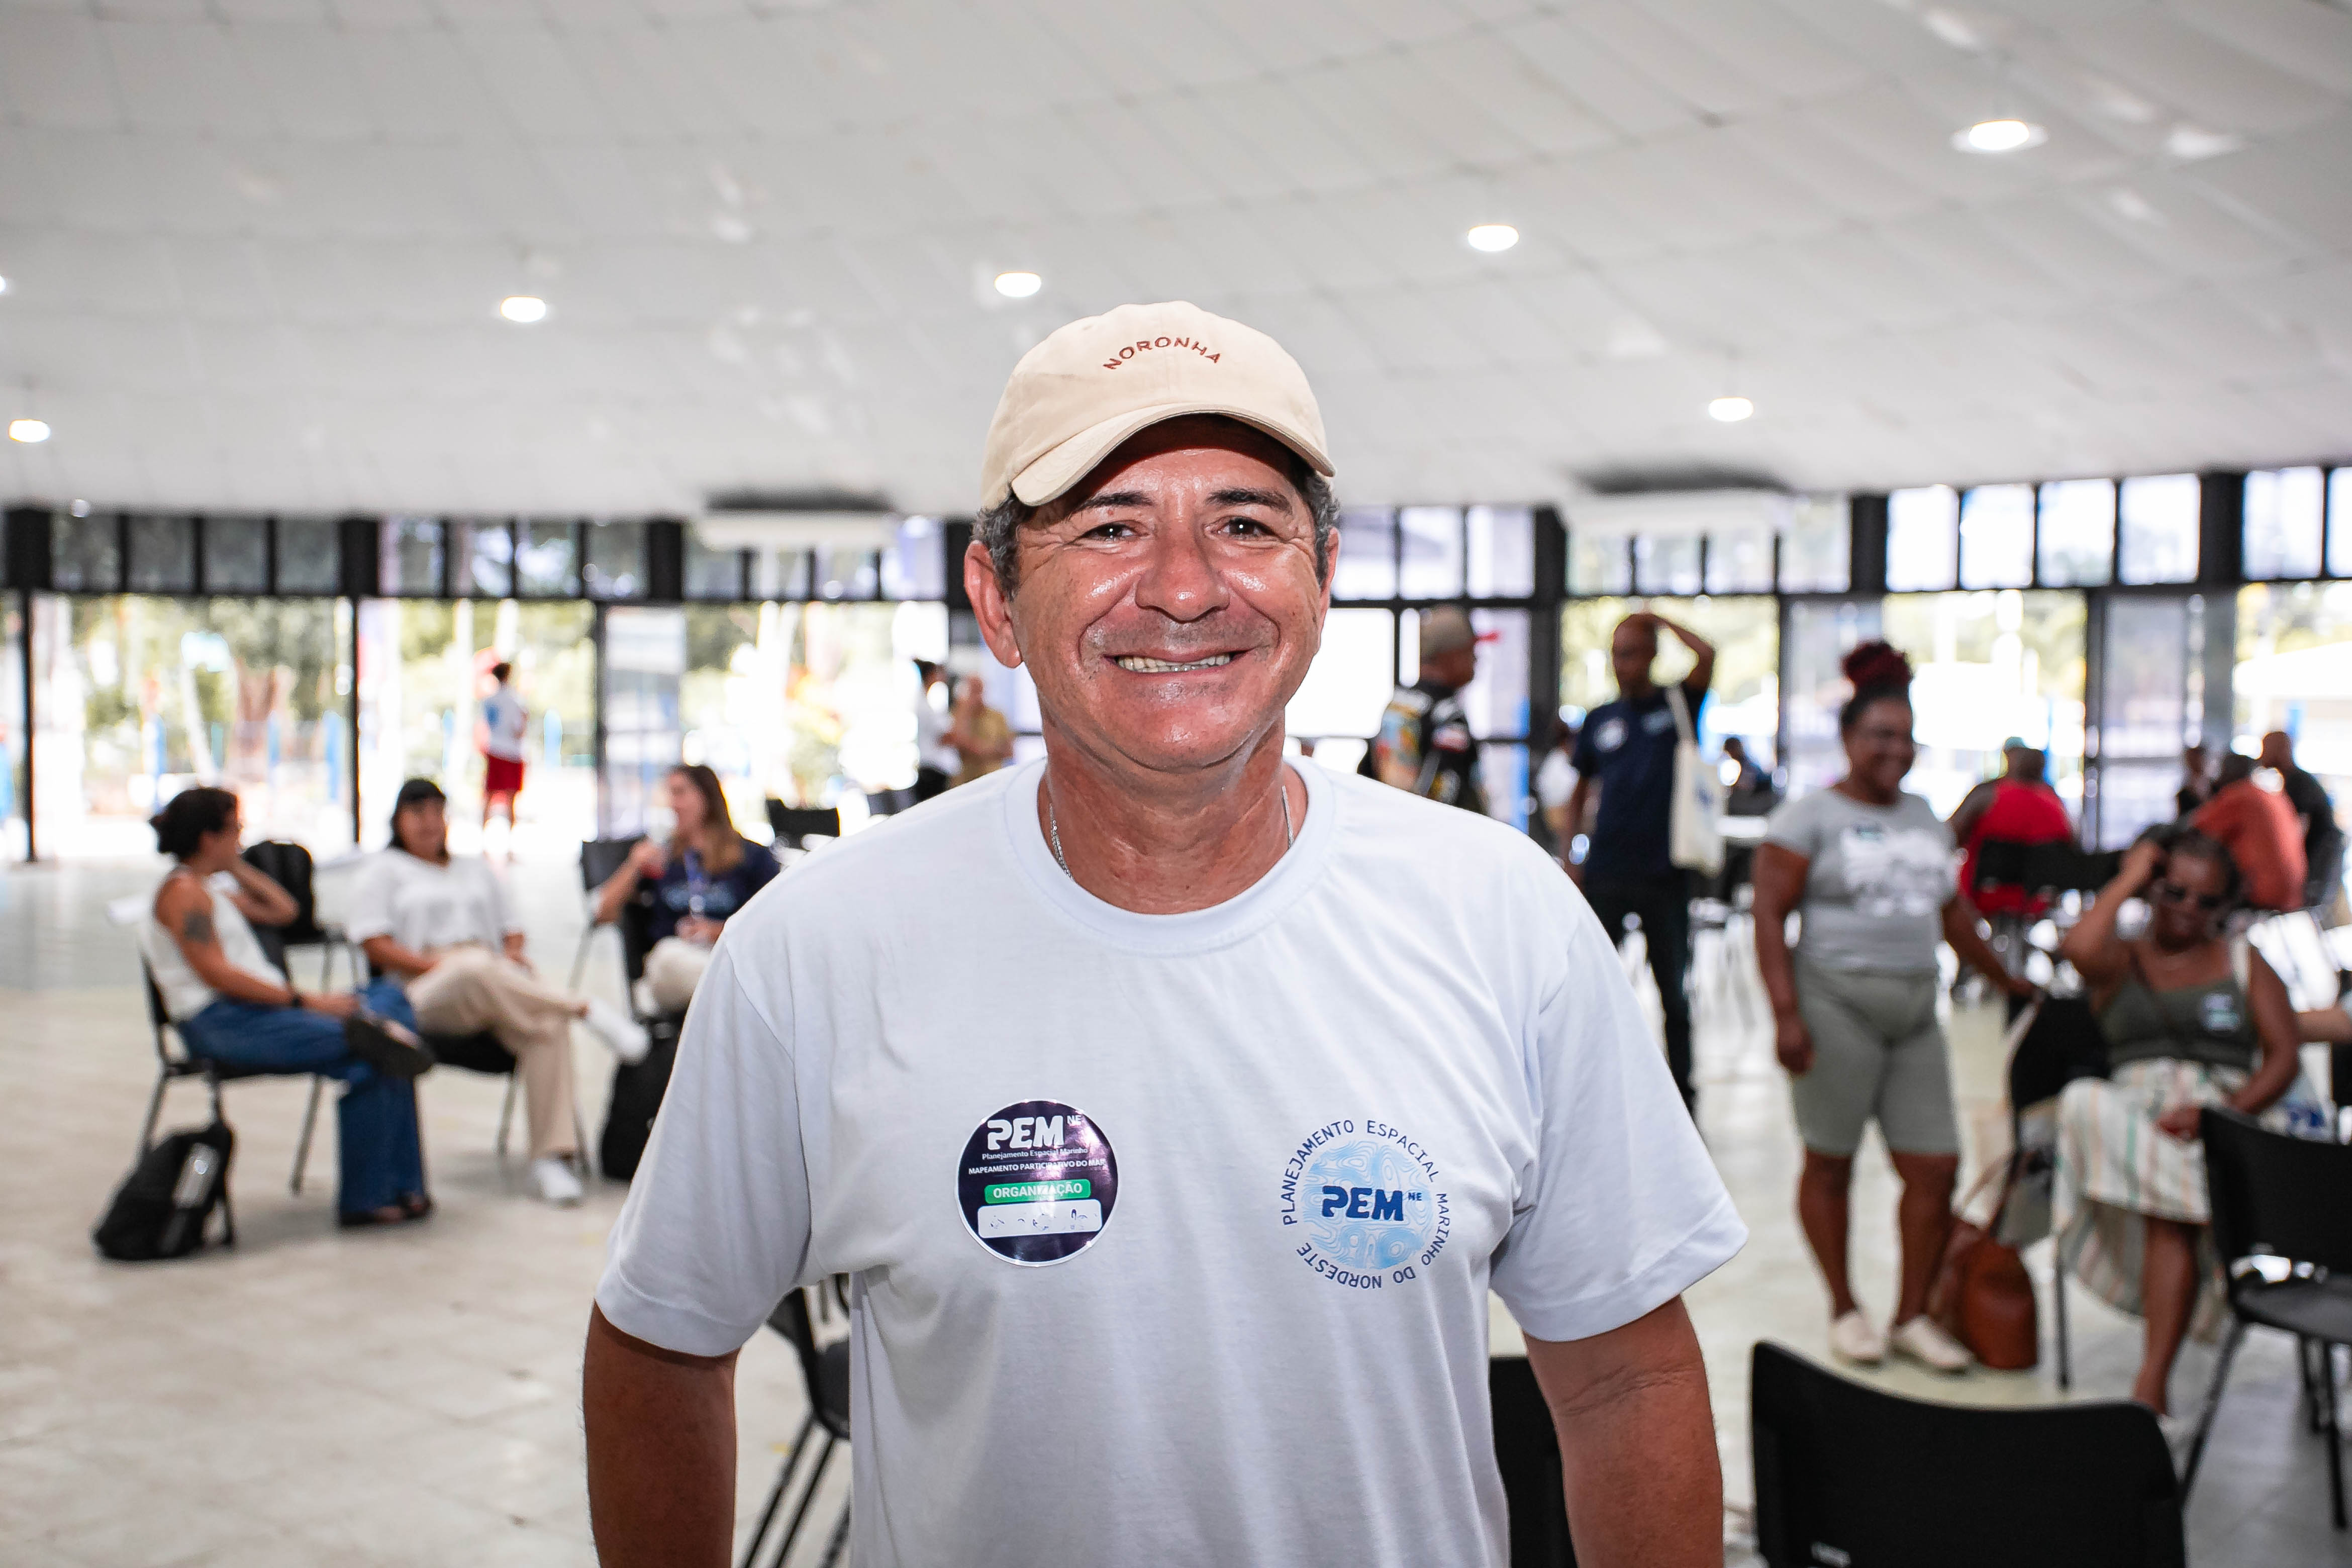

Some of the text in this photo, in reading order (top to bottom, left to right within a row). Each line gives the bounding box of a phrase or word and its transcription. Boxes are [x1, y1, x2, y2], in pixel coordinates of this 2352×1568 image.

[1103, 337, 1220, 369] NORONHA
[987, 1115, 1081, 1150] PEM NE
[968, 1164, 1019, 1175] MAPEAMENTO
[1088, 1158, 1106, 1166] MAR
[982, 1147, 1088, 1160] Planejamento Espacial Marinho
[993, 1182, 1083, 1198] ORGANIZAÇÃO
[1281, 1120, 1450, 1289] PLANEJAMENTO ESPACIAL MARINHO DO NORDESTE
[1322, 1185, 1404, 1221] PEM
